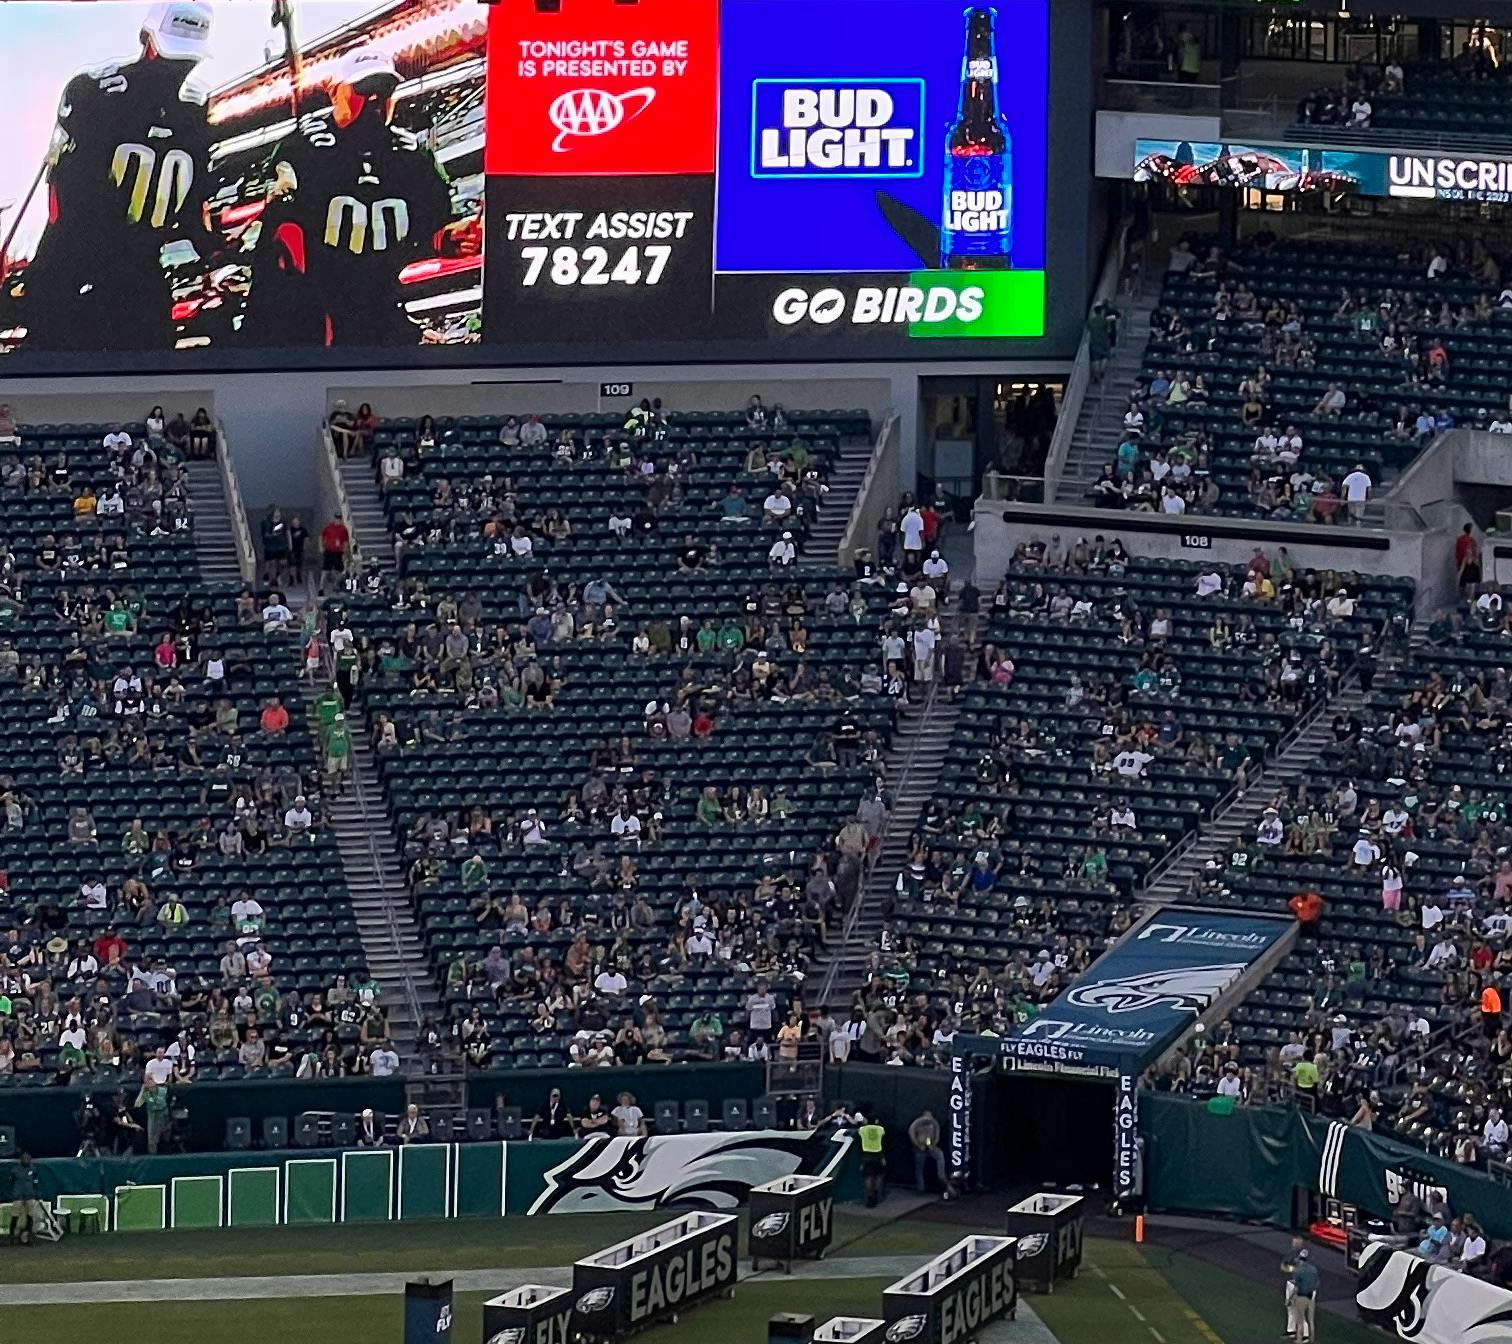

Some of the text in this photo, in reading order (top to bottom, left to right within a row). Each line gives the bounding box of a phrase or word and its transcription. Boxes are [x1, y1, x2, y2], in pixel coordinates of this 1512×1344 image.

[518, 40, 689, 58] TONIGHT'S GAME
[518, 60, 689, 77] IS PRESENTED BY
[556, 89, 619, 134] AAA
[783, 88, 895, 128] BUD
[951, 190, 1003, 211] BUD
[505, 211, 695, 241] TEXT ASSIST
[945, 209, 1009, 232] LIGHT
[520, 244, 672, 287] 78247
[772, 286, 985, 325] GO BIRDS
[604, 383, 630, 396] 109
[1184, 534, 1209, 548] 108
[1000, 1042, 1017, 1053] FLY
[1017, 1042, 1067, 1060] EAGLES
[1067, 1050, 1084, 1060] FLY
[949, 1056, 964, 1166] EAGLES
[1118, 1074, 1134, 1186] EAGLES
[799, 1197, 834, 1245] FLY
[630, 1234, 733, 1322] EAGLES
[941, 1257, 1015, 1344] EAGLES
